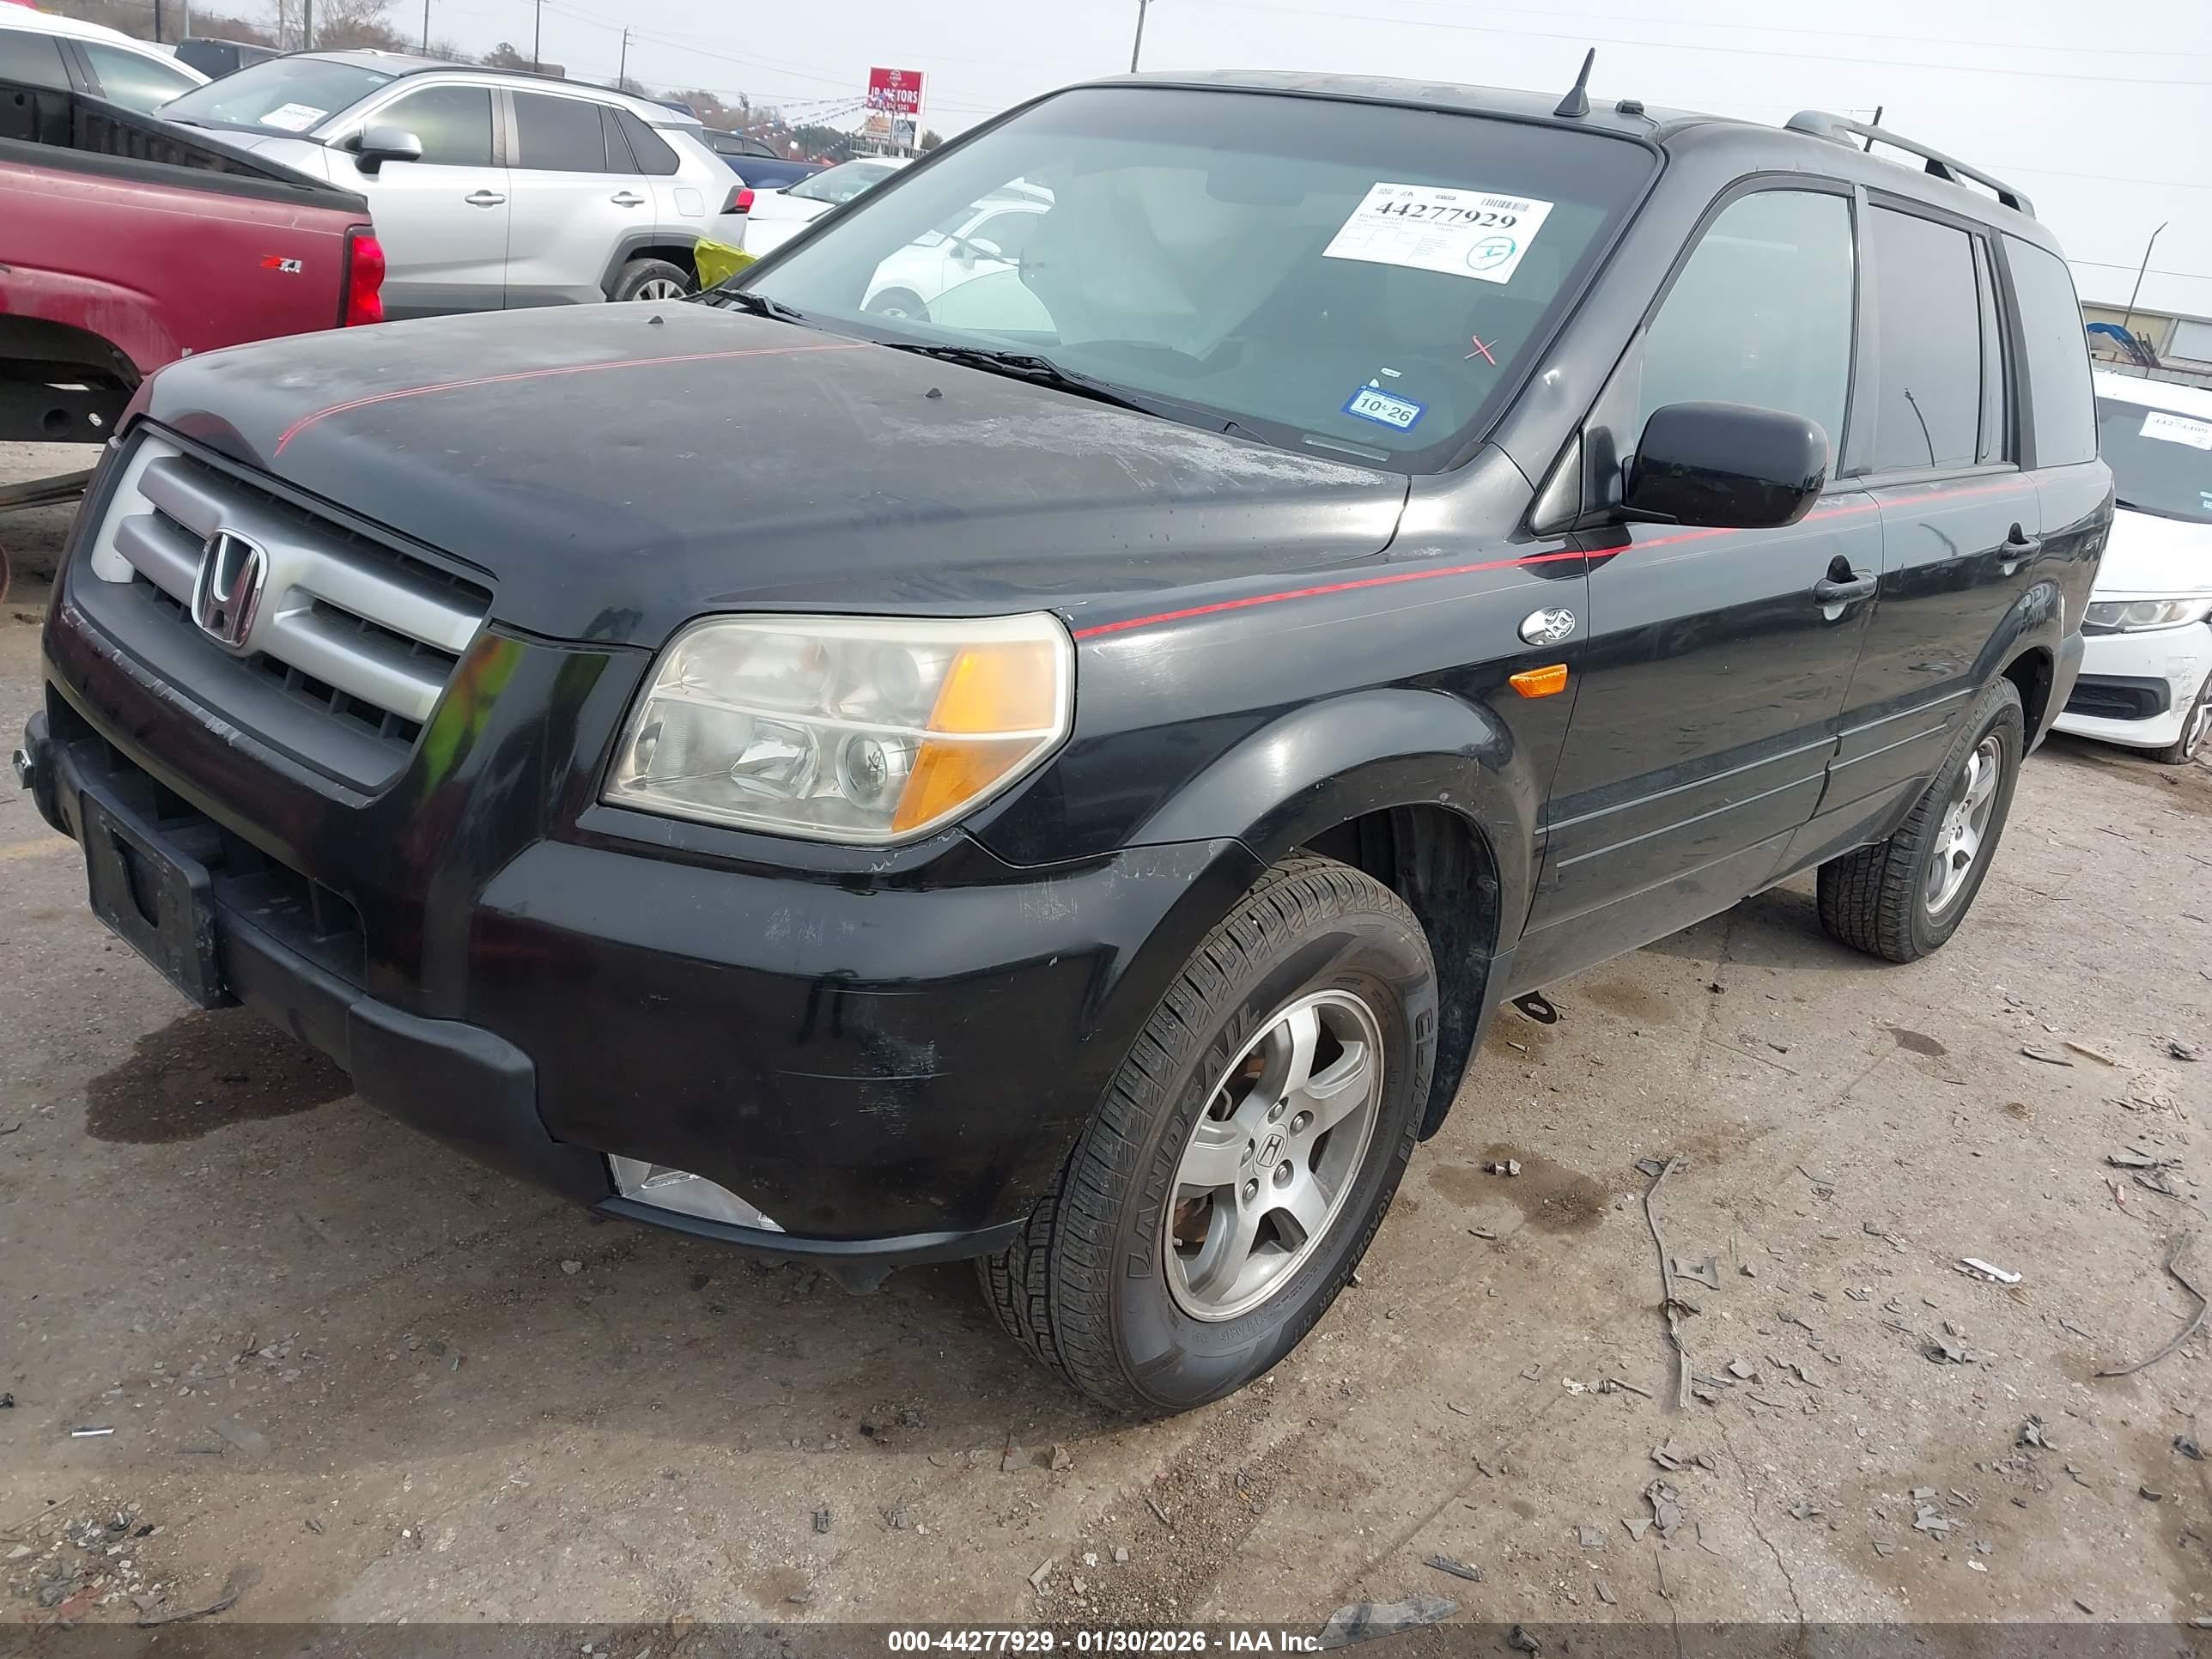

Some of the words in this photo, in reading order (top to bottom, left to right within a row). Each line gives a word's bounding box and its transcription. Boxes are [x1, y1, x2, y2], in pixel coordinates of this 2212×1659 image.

[1376, 201, 1518, 229] 44277929
[1360, 398, 1382, 412] 10
[1388, 407, 1413, 422] 26
[1127, 1002, 1260, 1279] LANDSAIL
[1319, 1188, 1393, 1313] ROADBLAZER
